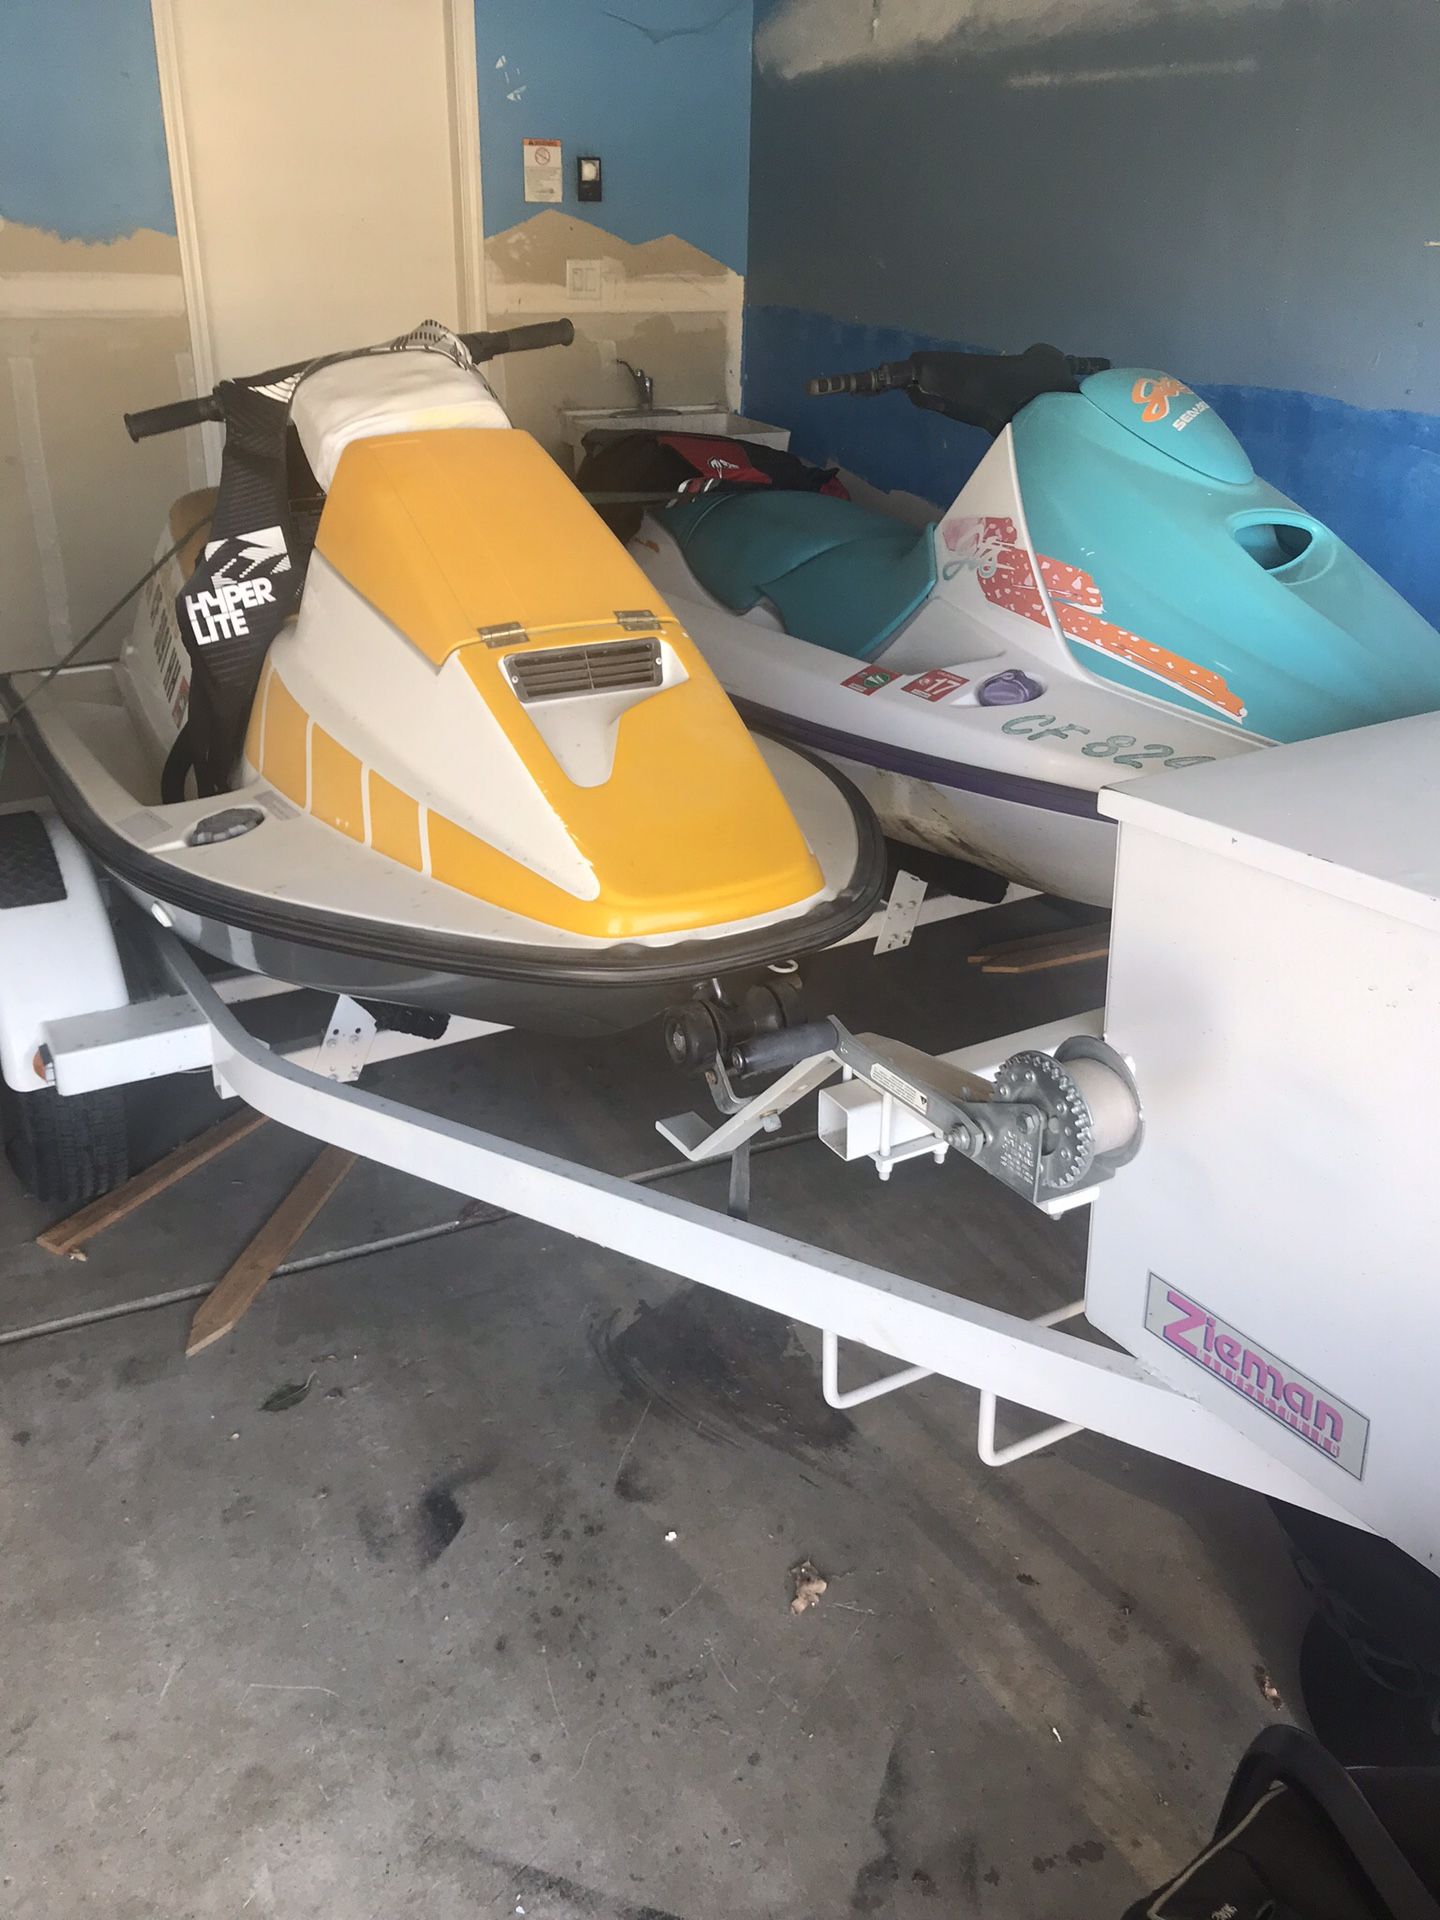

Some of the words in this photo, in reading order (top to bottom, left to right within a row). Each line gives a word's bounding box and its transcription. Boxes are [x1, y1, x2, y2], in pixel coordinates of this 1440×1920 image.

[185, 576, 276, 621] HYPER
[190, 608, 250, 645] LITE
[924, 678, 961, 695] 17
[1001, 714, 1090, 741] CF
[1162, 1290, 1343, 1443] Zieman
